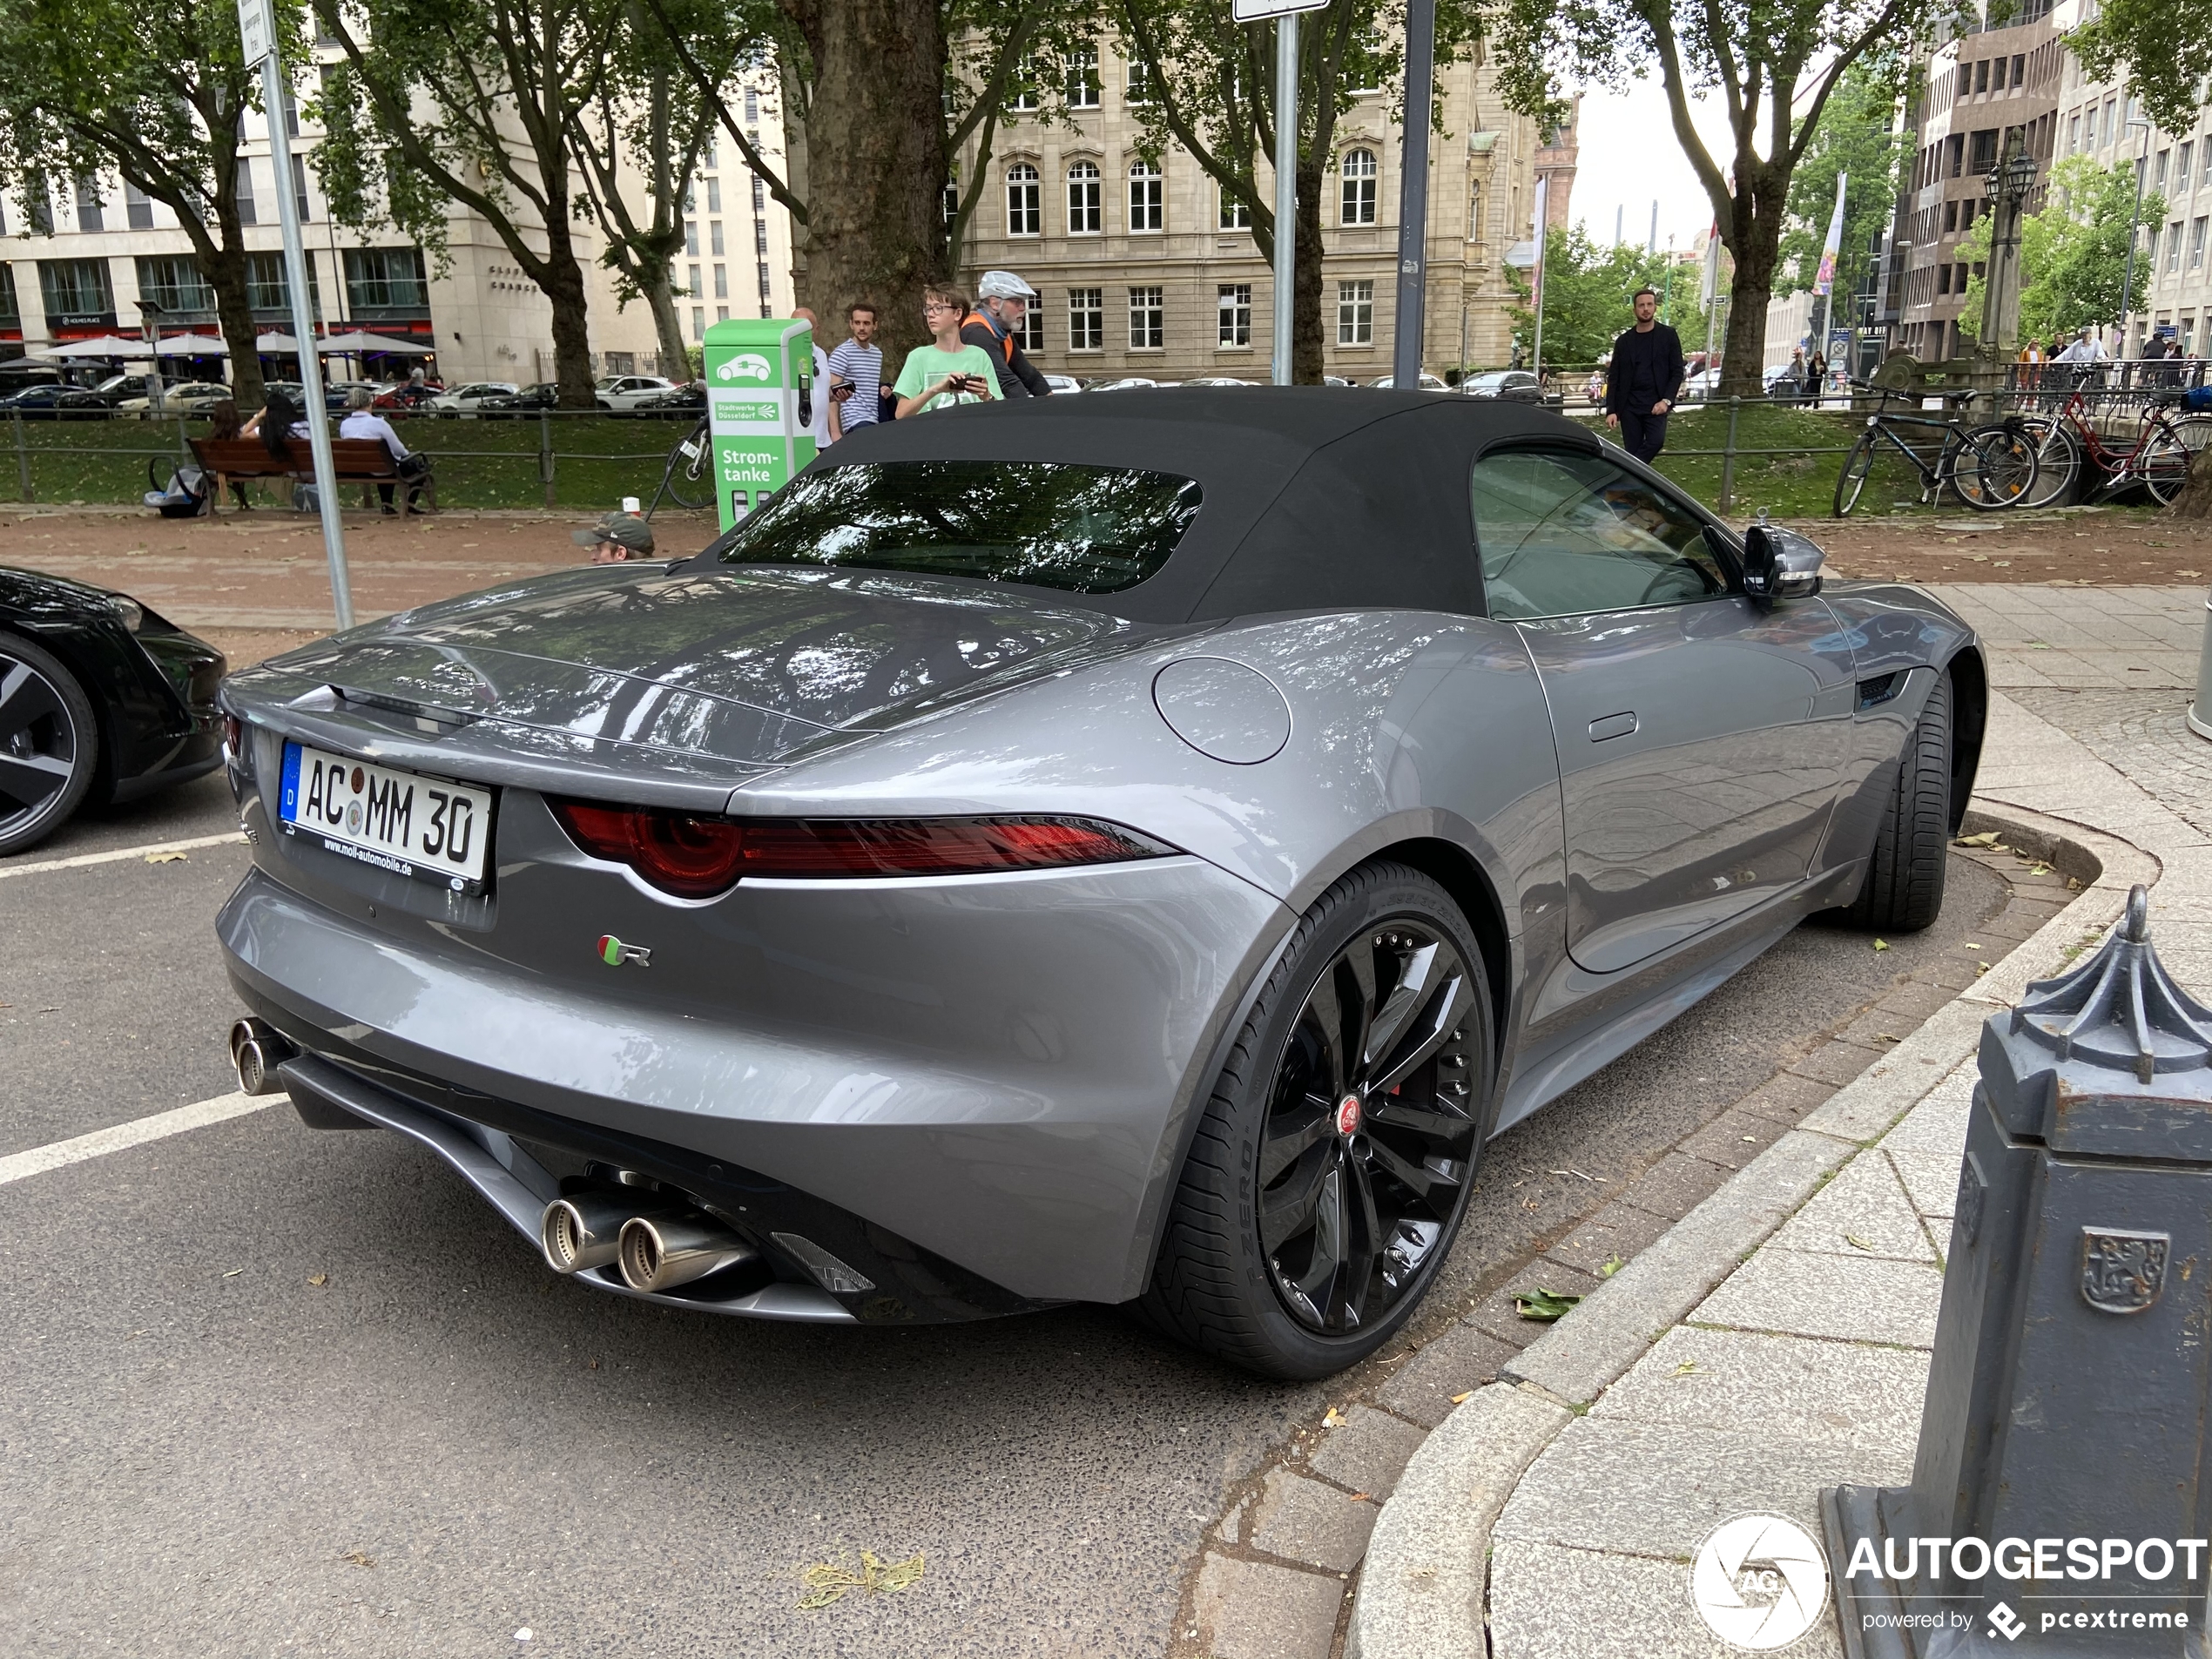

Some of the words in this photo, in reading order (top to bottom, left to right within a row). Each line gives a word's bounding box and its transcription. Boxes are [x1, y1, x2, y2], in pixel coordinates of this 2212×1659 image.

[723, 449, 779, 464] Strom-
[724, 467, 771, 482] tanke
[287, 789, 293, 806] D
[306, 759, 346, 825] AC
[365, 774, 415, 847] MM
[423, 789, 473, 864] 30
[324, 838, 412, 876] www.moll-automobile.de
[1238, 1139, 1254, 1257] ZERO
